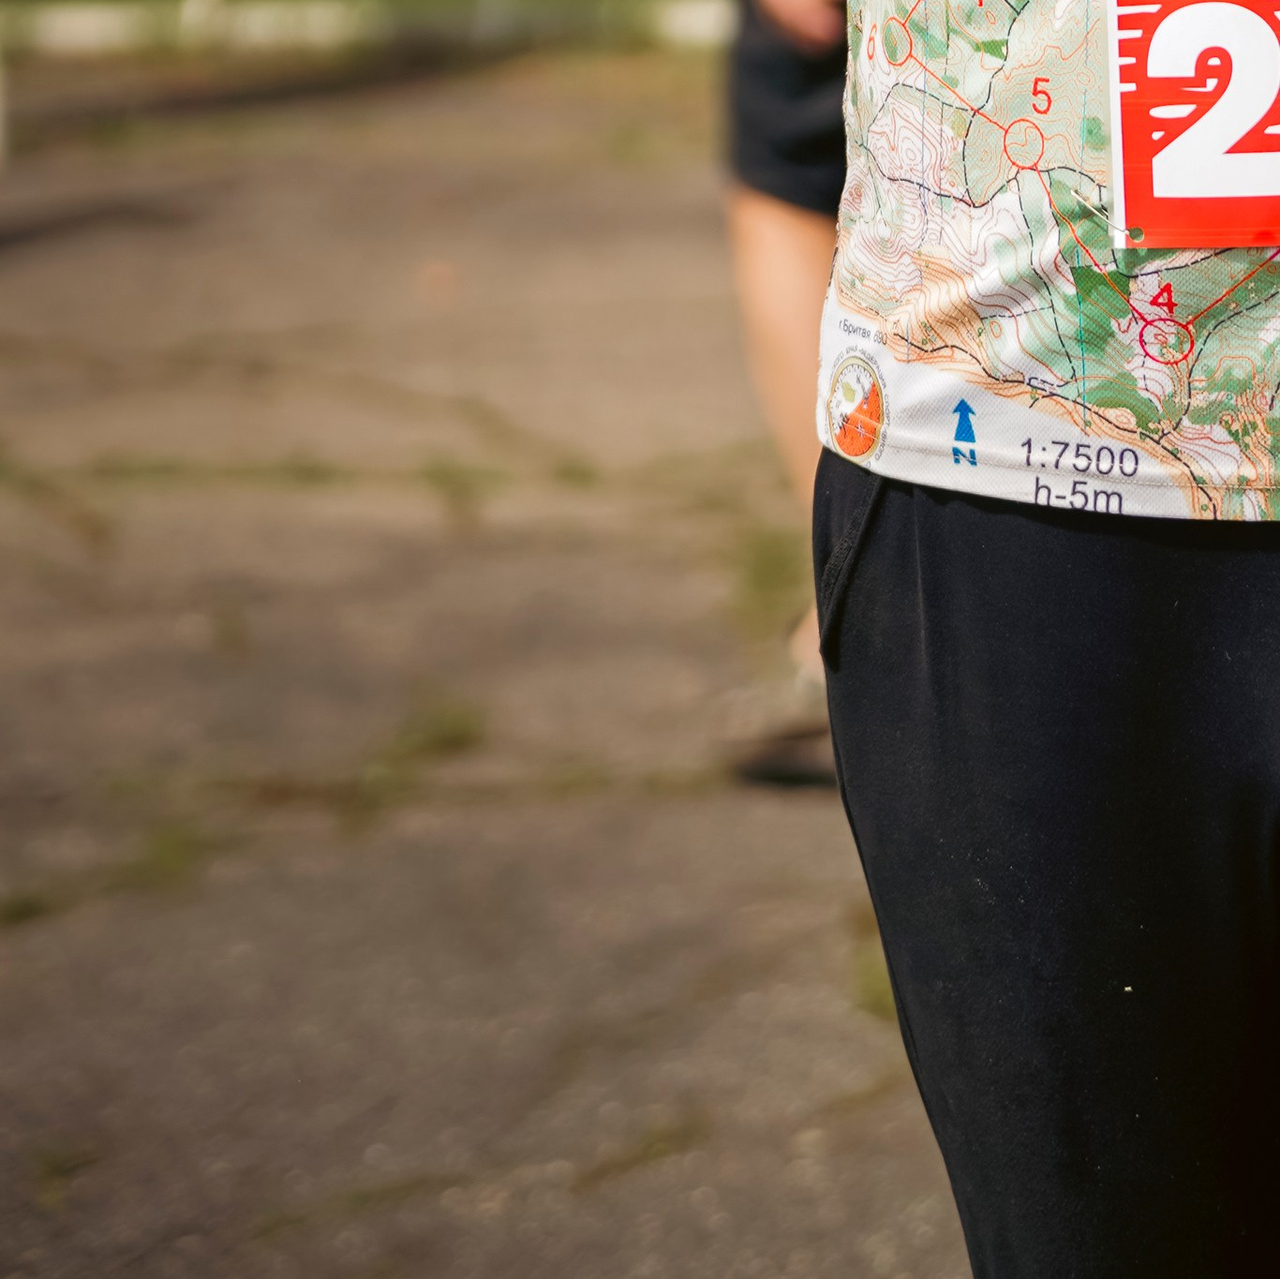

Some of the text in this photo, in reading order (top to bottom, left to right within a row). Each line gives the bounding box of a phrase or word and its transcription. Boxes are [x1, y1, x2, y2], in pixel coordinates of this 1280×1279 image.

[1032, 77, 1053, 115] 5
[1150, 283, 1178, 314] 4
[1021, 438, 1140, 478] 1:7500
[1034, 477, 1123, 514] h-5m
